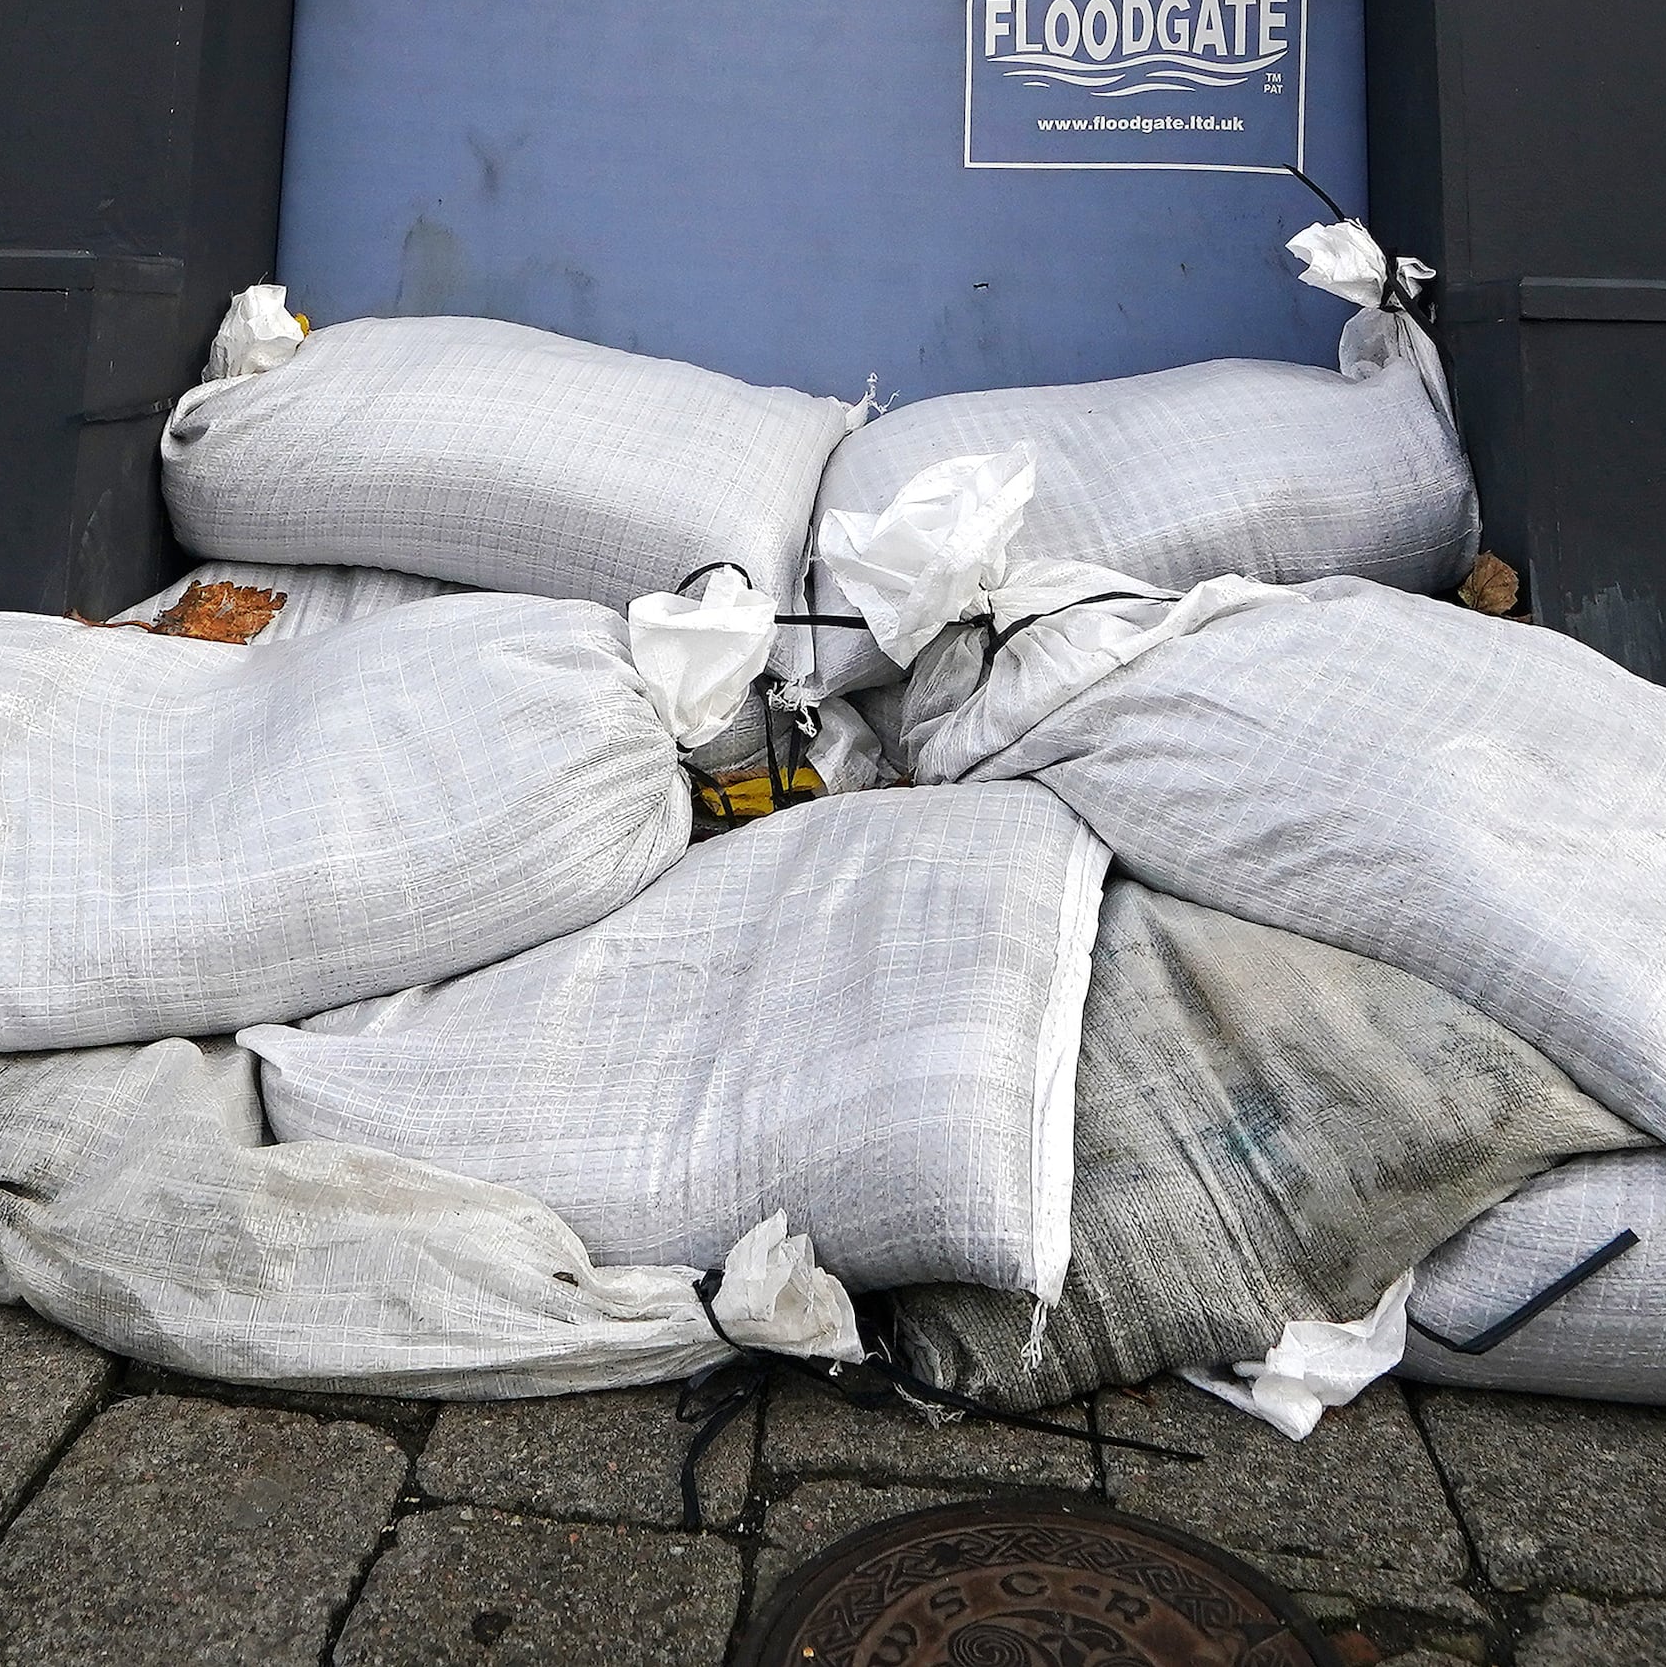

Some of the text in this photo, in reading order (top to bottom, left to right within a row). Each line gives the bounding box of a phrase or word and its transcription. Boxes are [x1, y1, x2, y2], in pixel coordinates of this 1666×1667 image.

[1265, 72, 1283, 83] TM
[1262, 84, 1284, 94] PAT
[1036, 115, 1245, 133] www.floodgate.ltd.uk
